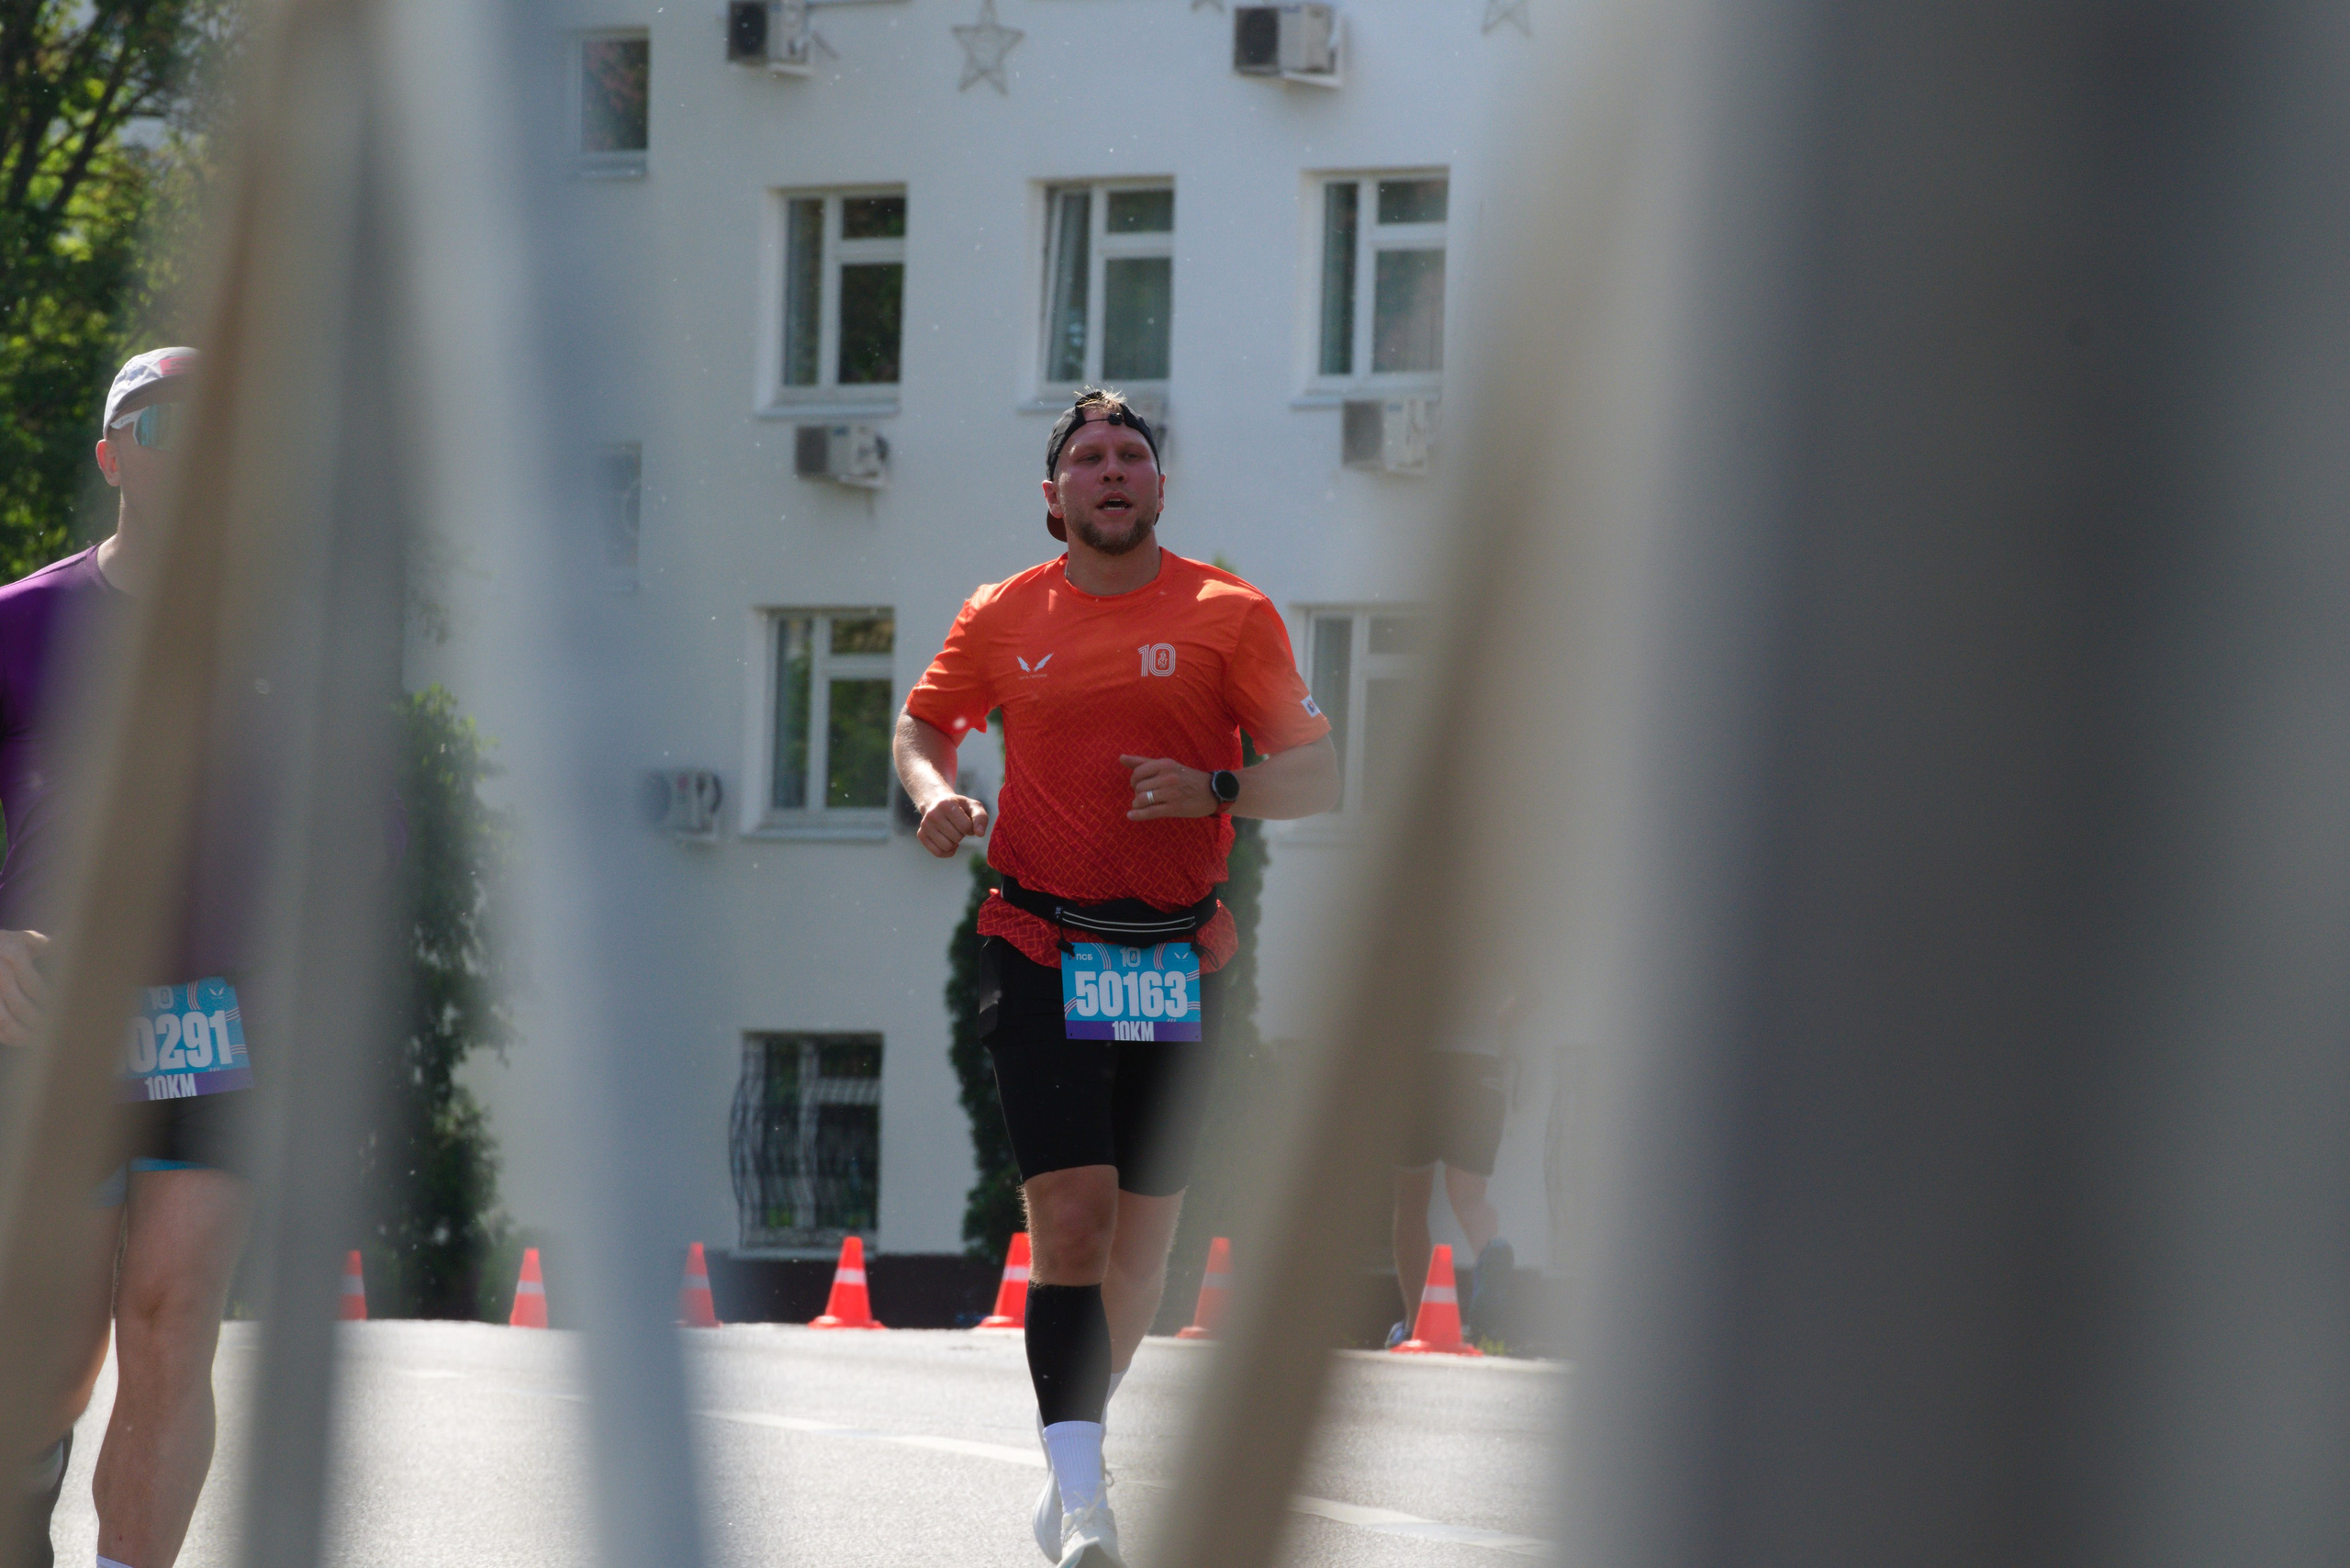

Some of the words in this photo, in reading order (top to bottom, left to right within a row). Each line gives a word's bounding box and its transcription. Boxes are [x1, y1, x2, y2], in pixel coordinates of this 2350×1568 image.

[1137, 643, 1176, 678] 10
[1076, 953, 1093, 961] ПСБ
[1119, 947, 1141, 968] 10
[1074, 970, 1188, 1018] 50163
[126, 1010, 234, 1074] 0291
[1112, 1020, 1155, 1042] 10KM
[144, 1072, 198, 1101] 10KM
